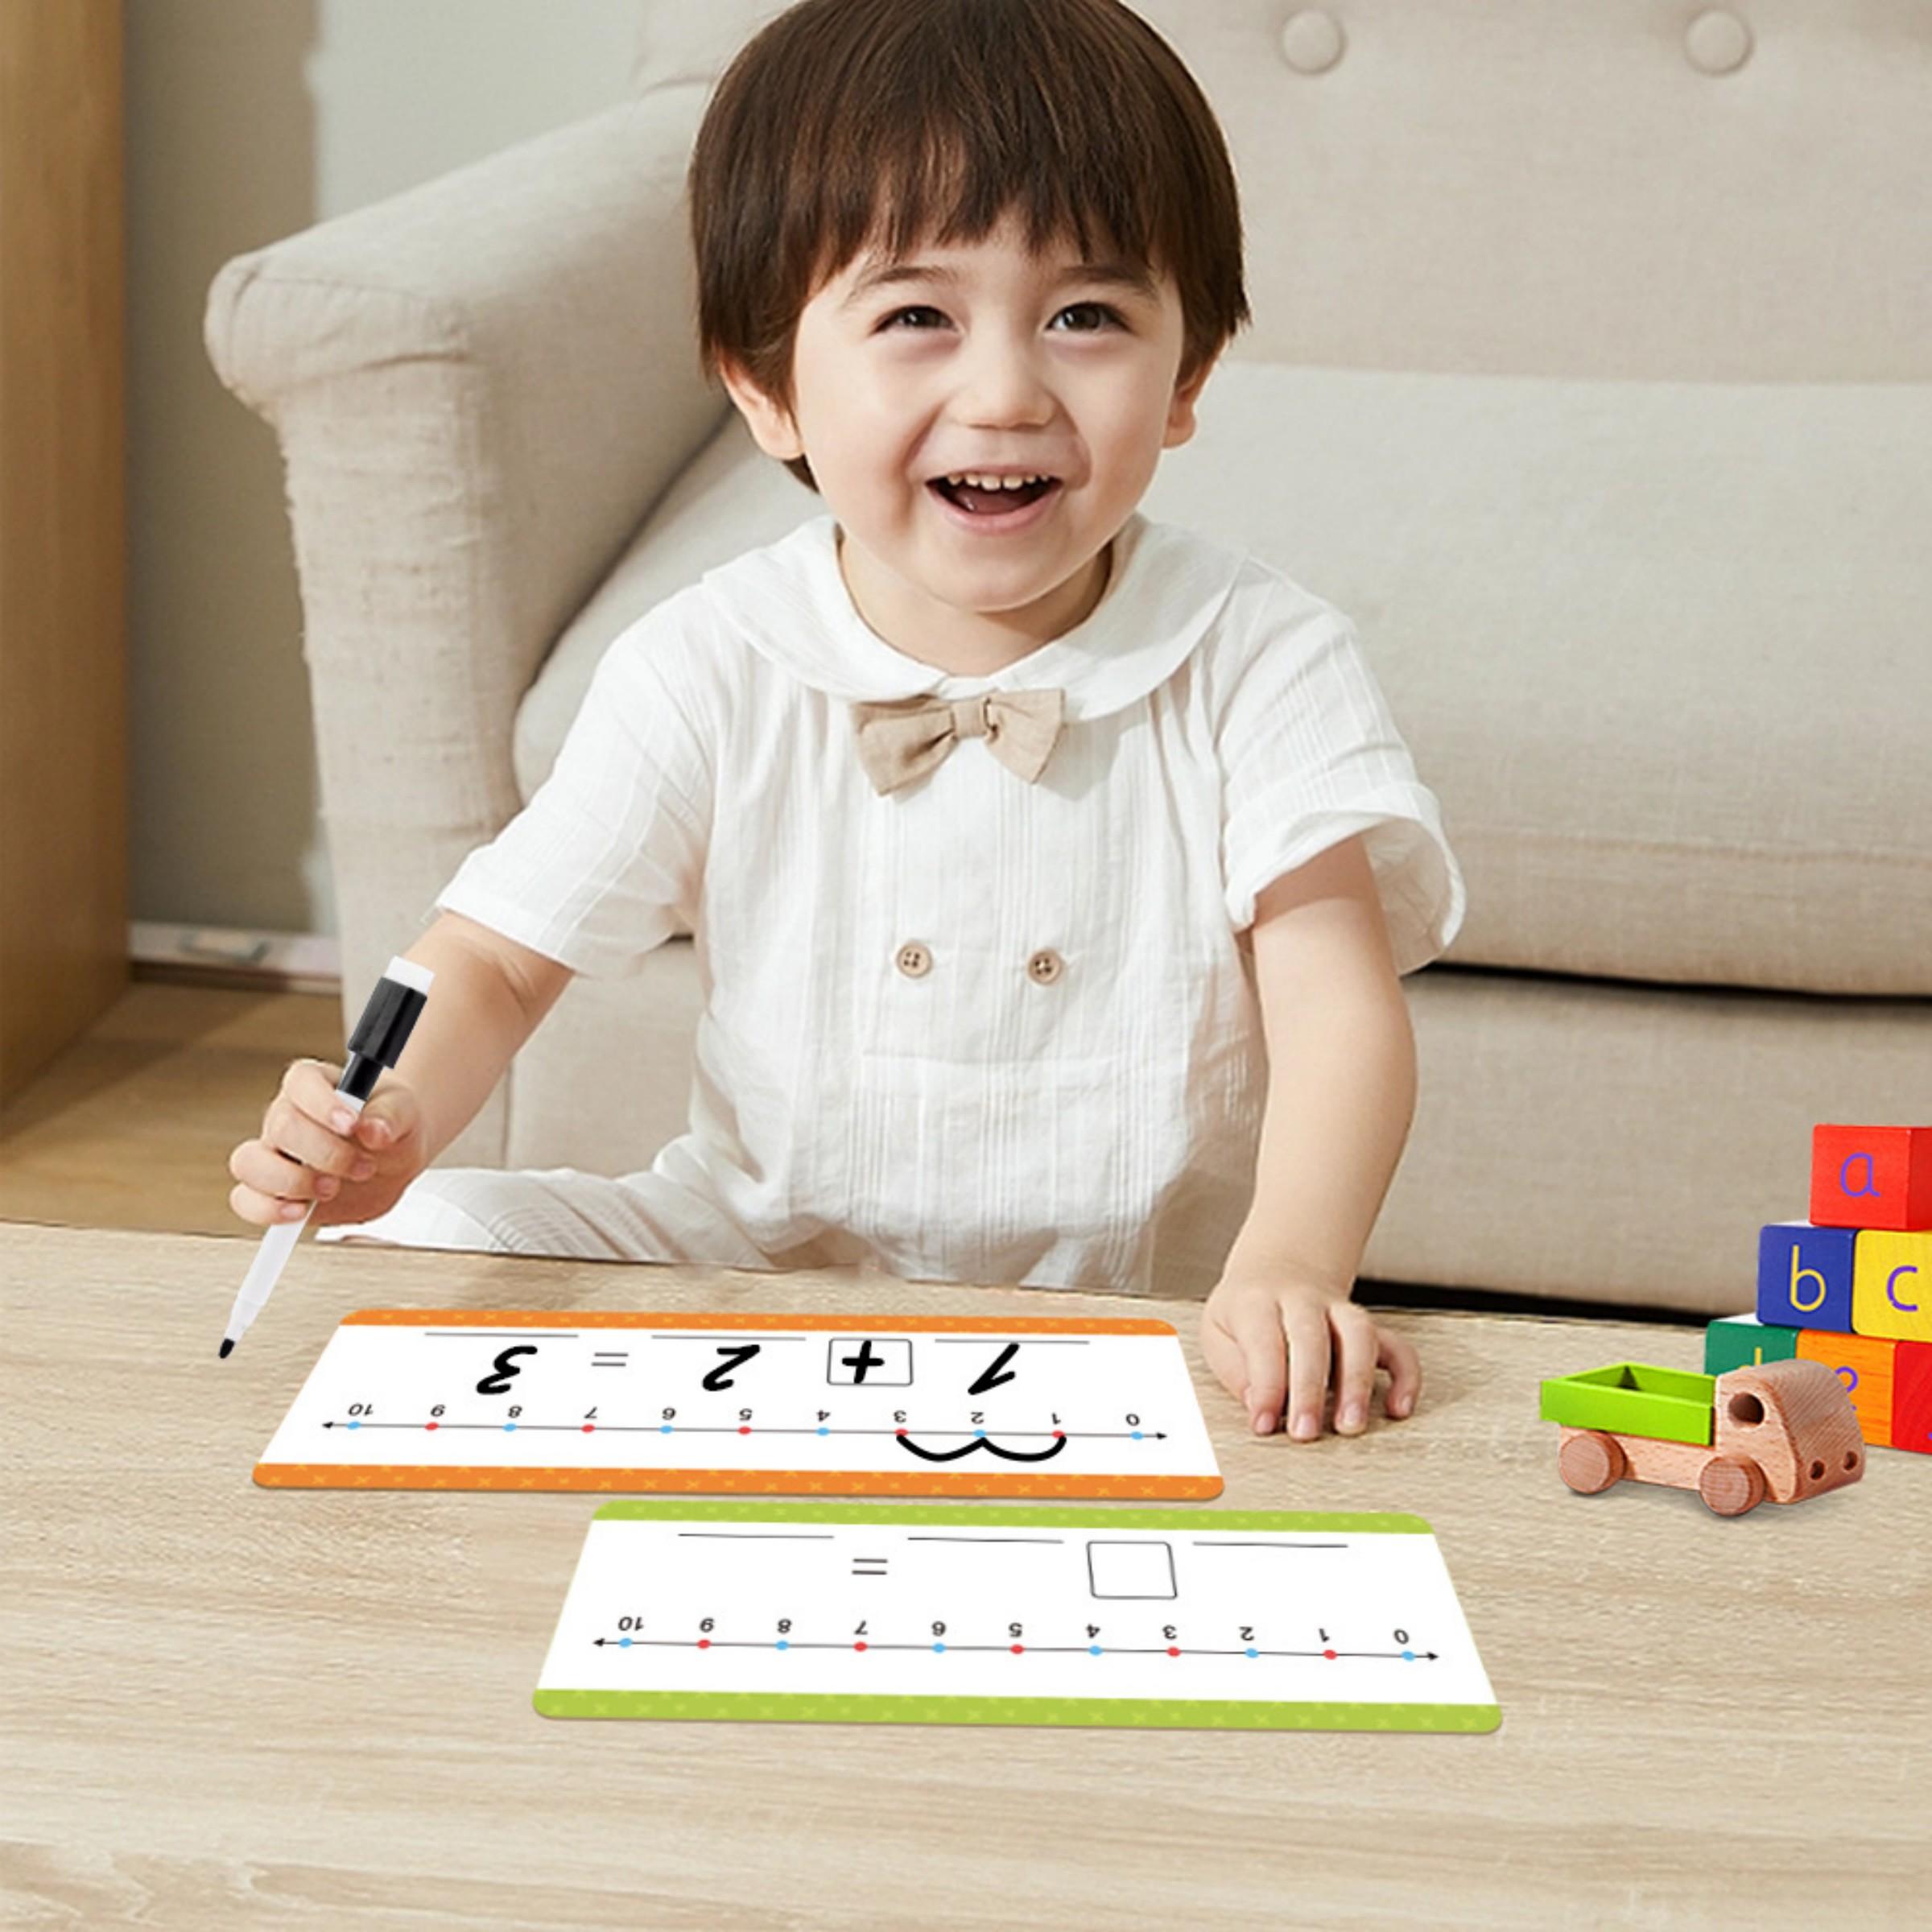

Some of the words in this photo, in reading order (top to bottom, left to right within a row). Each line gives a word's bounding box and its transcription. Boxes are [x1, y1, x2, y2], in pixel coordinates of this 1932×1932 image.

[1839, 1152, 1881, 1198] a
[1789, 1245, 1827, 1312] b
[1885, 1265, 1919, 1312] c
[591, 1352, 629, 1367] =
[841, 1340, 885, 1385] +
[476, 1344, 539, 1395] 3
[702, 1344, 762, 1392] 2
[967, 1342, 1020, 1396] 1
[348, 1403, 373, 1417] 10
[430, 1404, 446, 1418] 9
[507, 1405, 523, 1418] 8
[584, 1406, 597, 1419] 7
[662, 1407, 677, 1421] 6
[738, 1408, 753, 1422] 5
[816, 1410, 831, 1422] 4
[893, 1410, 906, 1423] 3
[970, 1411, 985, 1425] 2
[1051, 1412, 1062, 1426] 1
[1125, 1413, 1141, 1426] 0
[852, 1558, 888, 1576] =
[617, 1616, 644, 1632] 10
[699, 1617, 714, 1633] 9
[777, 1618, 793, 1634] 8
[854, 1620, 868, 1636] 7
[931, 1620, 947, 1637] 6
[1008, 1622, 1023, 1638] 5
[1086, 1624, 1101, 1639] 4
[1162, 1624, 1177, 1641] 3
[1239, 1626, 1255, 1641] 2
[1319, 1628, 1330, 1643] 1
[1393, 1629, 1410, 1645] 0
